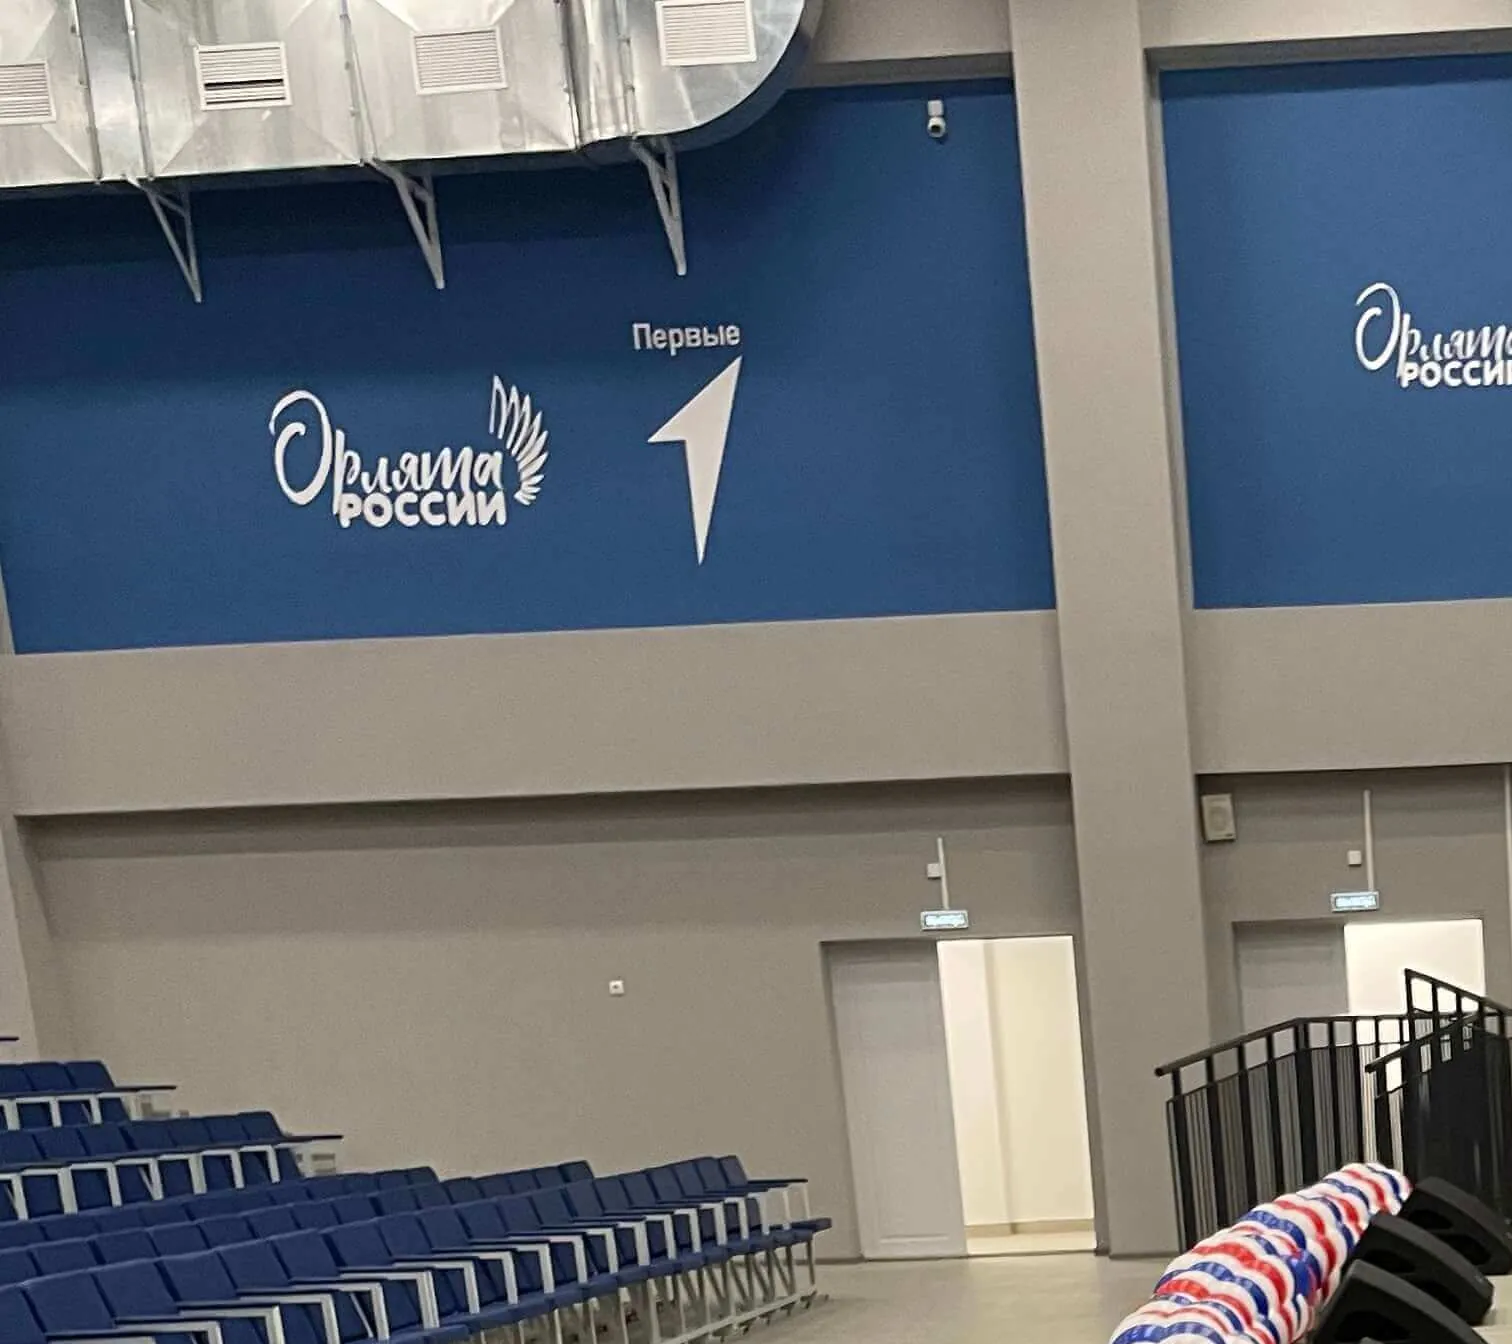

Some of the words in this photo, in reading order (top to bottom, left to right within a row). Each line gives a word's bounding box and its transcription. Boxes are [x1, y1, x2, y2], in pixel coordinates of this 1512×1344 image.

[632, 323, 741, 356] Первые
[268, 390, 505, 515] Орлята
[339, 489, 507, 528] РОССИИ
